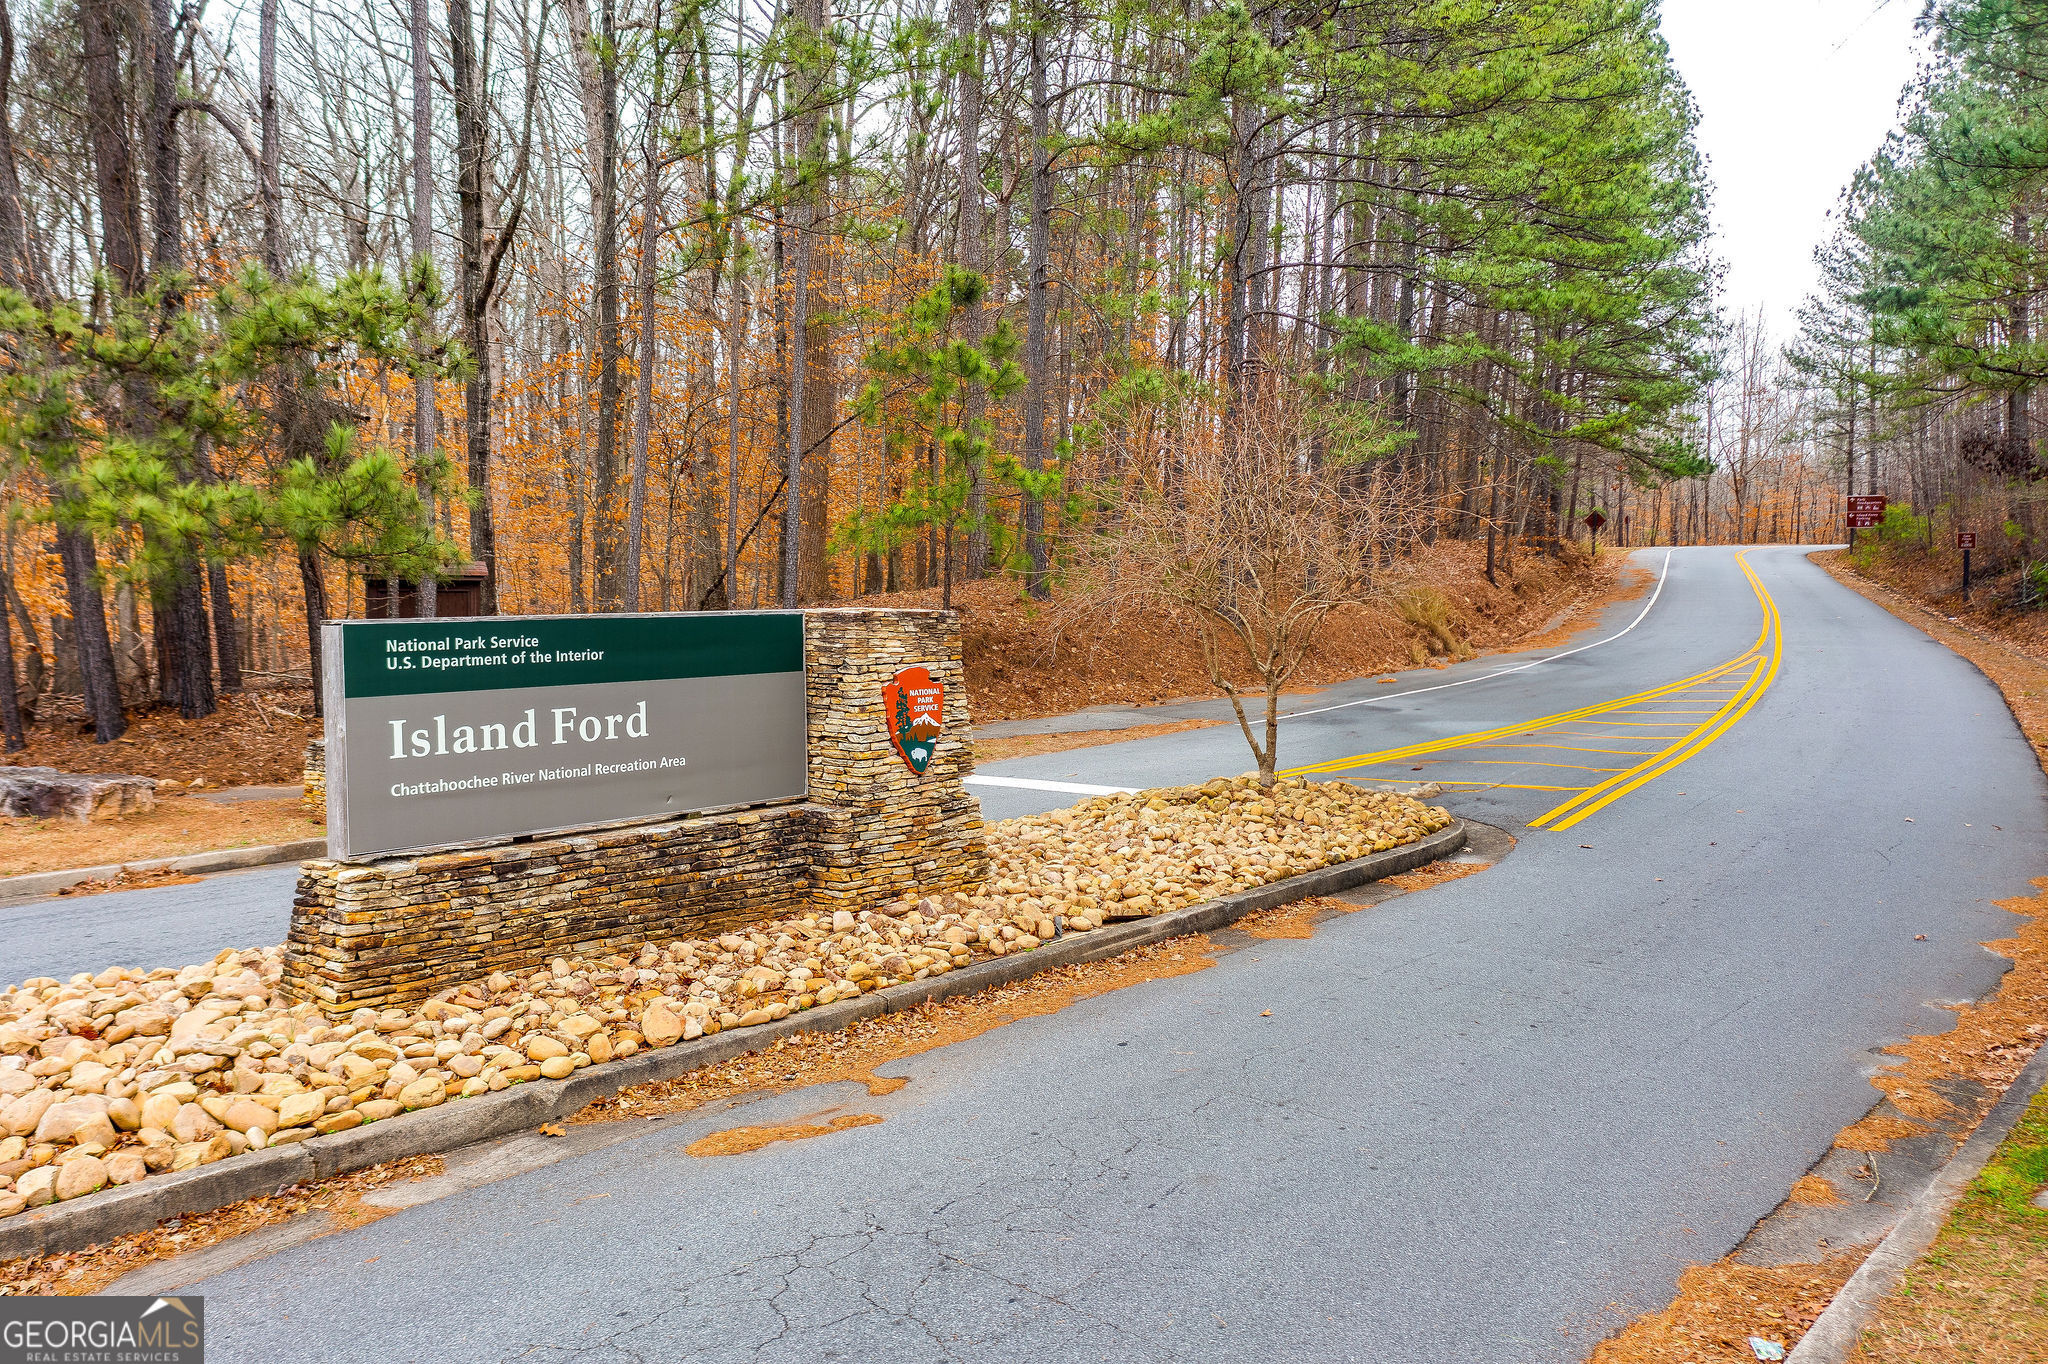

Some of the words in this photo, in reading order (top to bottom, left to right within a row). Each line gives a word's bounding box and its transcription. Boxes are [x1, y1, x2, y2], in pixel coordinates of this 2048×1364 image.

[386, 637, 449, 653] National
[455, 636, 486, 650] Park
[491, 634, 540, 649] Service
[387, 656, 416, 670] U.S.
[421, 653, 507, 671] Department
[511, 651, 526, 664] of
[529, 650, 552, 663] the
[556, 648, 604, 663] Interior
[909, 688, 940, 697] NATIONAL
[917, 696, 933, 704] PARK
[913, 704, 938, 713] SERVICE
[388, 708, 539, 760] Island
[551, 700, 650, 745] Ford
[390, 775, 499, 797] Chattahoochee
[502, 769, 535, 786] River
[538, 763, 592, 781] National
[595, 758, 657, 777] Recreation
[659, 755, 687, 769] Area
